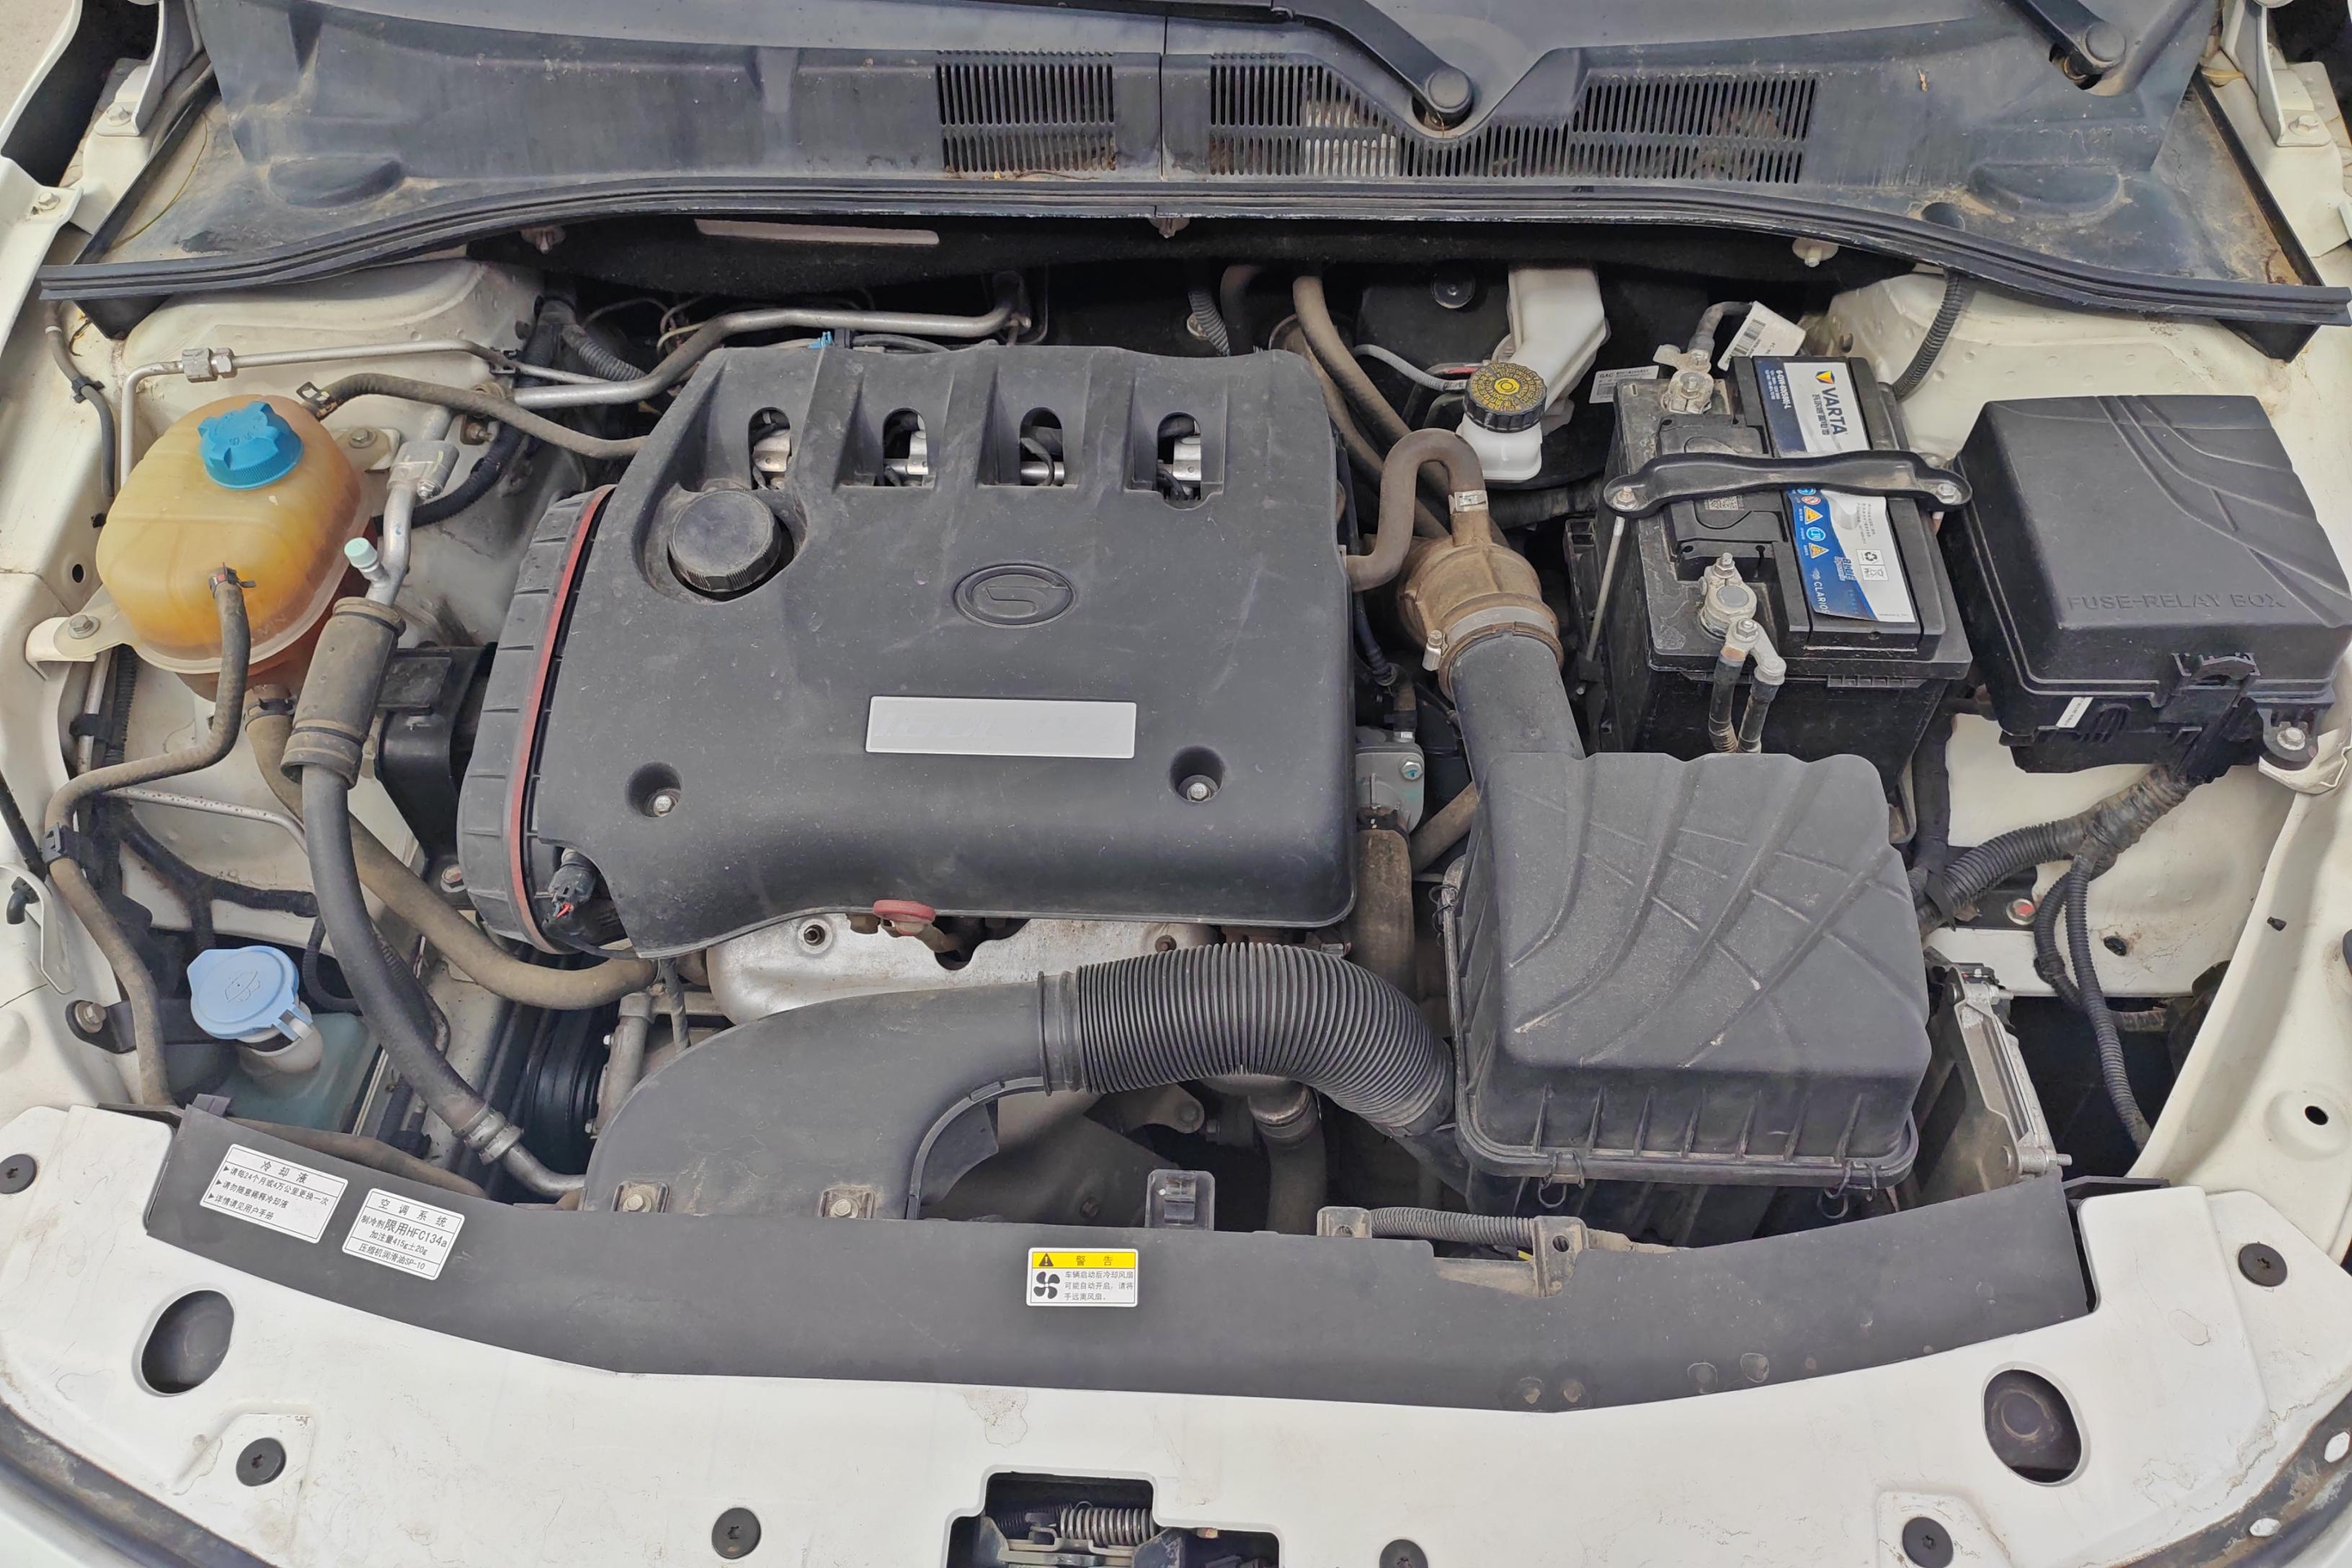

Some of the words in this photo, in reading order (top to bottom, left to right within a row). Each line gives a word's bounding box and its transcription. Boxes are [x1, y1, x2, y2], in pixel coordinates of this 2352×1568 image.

[1822, 387, 1848, 435] VARTA
[1814, 581, 1830, 614] CLARIOS
[2066, 593, 2221, 610] FUSE-RELAY
[2230, 592, 2287, 608] BOX
[229, 1166, 329, 1206] 请每24个月或4万公里更换一次
[260, 1160, 310, 1184] 冷却液
[214, 1193, 275, 1221] 详情请见用户手册
[222, 1180, 290, 1209] 请勿随意稀释冷却液
[378, 1198, 448, 1228] 空调系统
[361, 1214, 448, 1248] 制冷剂限用HFC134a
[369, 1229, 429, 1256] 加注量415g±20g
[358, 1243, 426, 1270] 压缩机润滑油SP-10
[1075, 1255, 1113, 1267] 警告
[1064, 1270, 1133, 1279] 车辆启动后冷却风扇
